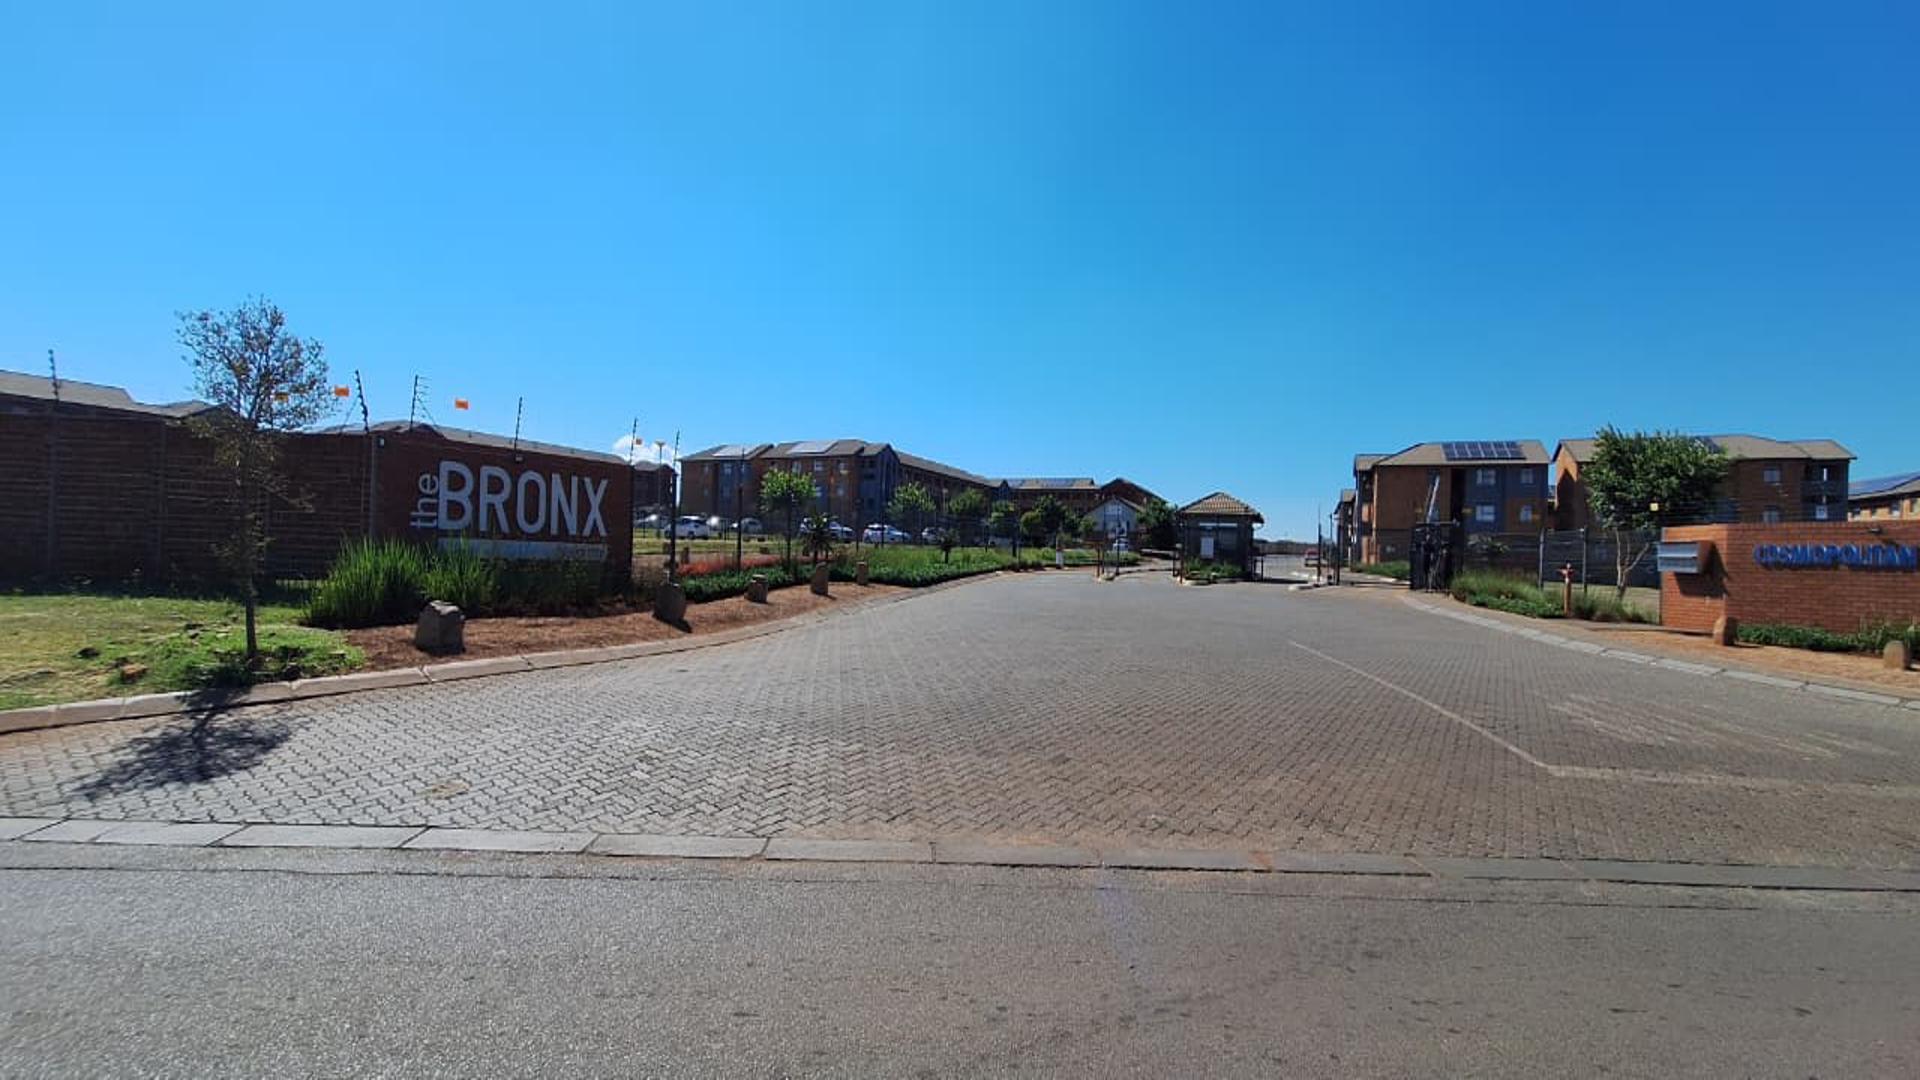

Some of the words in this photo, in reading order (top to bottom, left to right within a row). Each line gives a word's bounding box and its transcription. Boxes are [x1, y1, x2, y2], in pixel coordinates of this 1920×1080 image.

[410, 473, 438, 528] the
[437, 461, 608, 537] BRONX
[1754, 543, 1918, 570] COSMOPOLITAN
